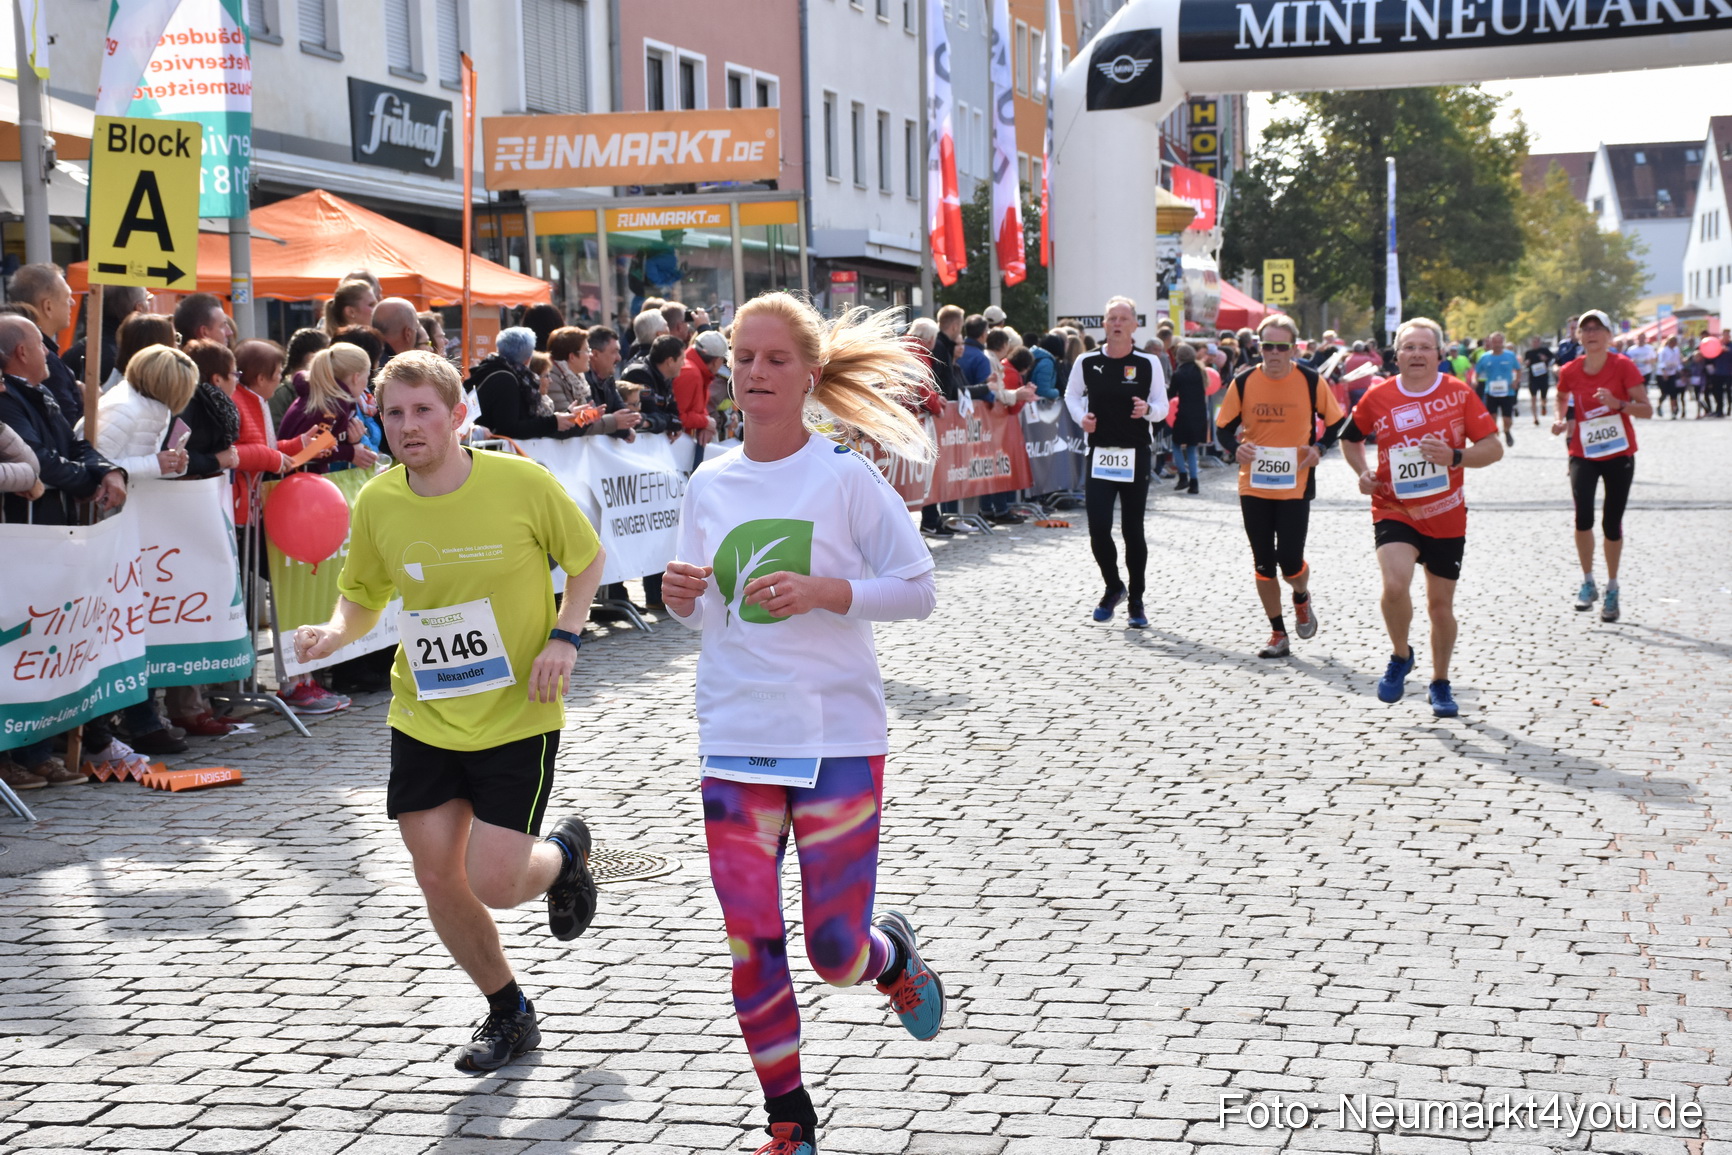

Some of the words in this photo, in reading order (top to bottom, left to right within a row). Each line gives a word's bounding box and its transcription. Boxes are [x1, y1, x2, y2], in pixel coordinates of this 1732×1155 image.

[1234, 2, 1383, 50] MINI
[108, 122, 191, 158] Block
[494, 130, 765, 171] RUNMARKT.DE
[113, 170, 175, 252] A
[617, 210, 721, 228] RUNMARKT.DE
[1271, 273, 1286, 294] B
[1587, 426, 1618, 443] 2408
[1099, 455, 1129, 467] 2013
[1257, 459, 1291, 473] 2560
[1397, 461, 1437, 480] 2071
[601, 474, 637, 508] BMW
[429, 613, 464, 625] BOCK
[416, 630, 488, 664] 2146
[437, 667, 485, 683] Alexander
[201, 771, 232, 784] DESIGN
